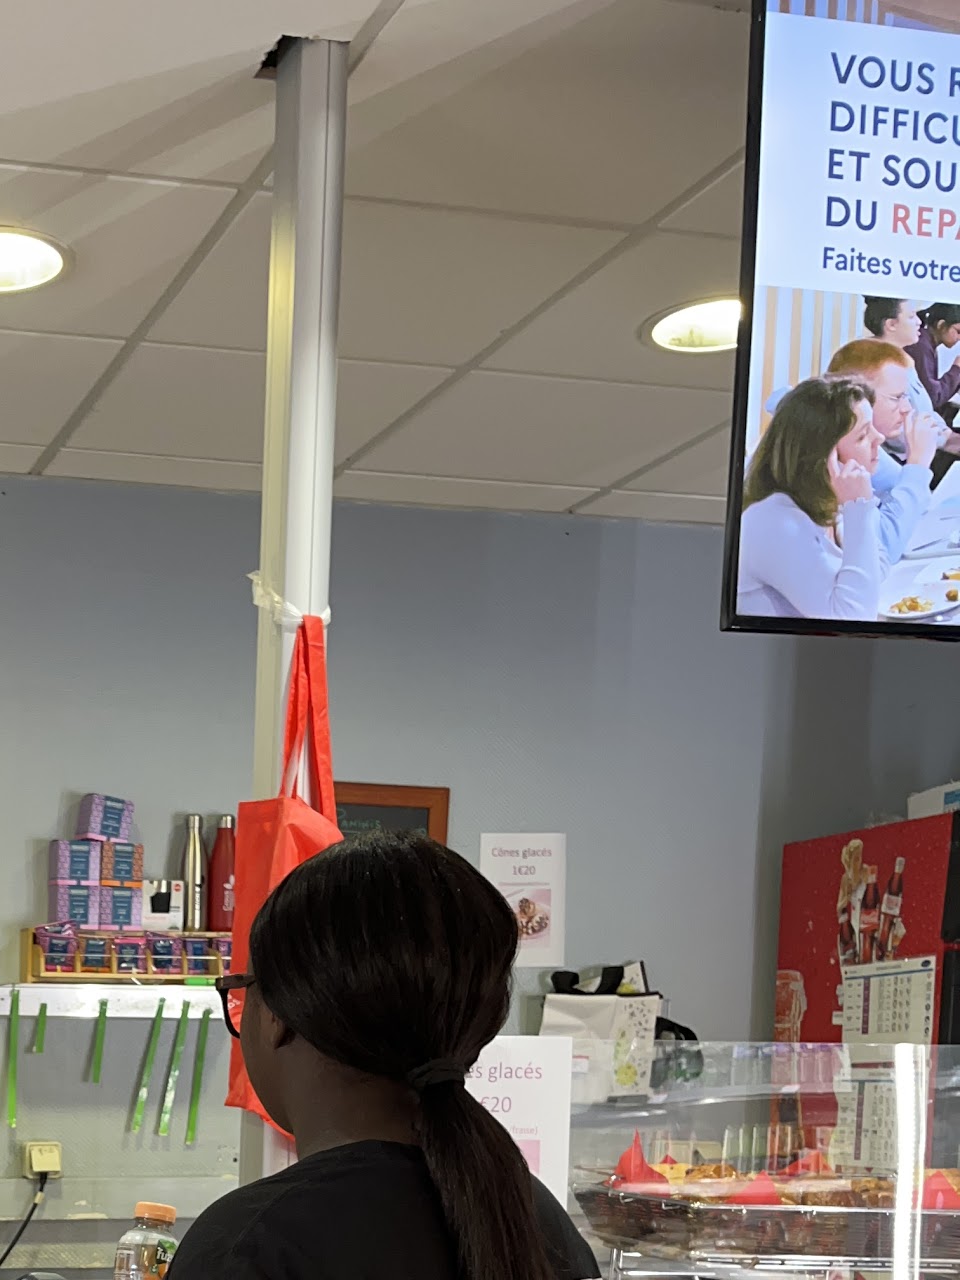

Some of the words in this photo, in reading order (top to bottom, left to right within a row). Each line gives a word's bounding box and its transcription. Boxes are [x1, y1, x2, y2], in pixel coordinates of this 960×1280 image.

[830, 52, 935, 95] VOUS
[827, 148, 871, 182] ET
[825, 196, 878, 231] DU
[892, 203, 960, 241] REP
[823, 246, 892, 276] Faites
[900, 258, 960, 283] votre
[491, 847, 520, 857] Cônes
[522, 848, 552, 859] glacés
[512, 865, 536, 875] 1€20
[487, 1061, 542, 1083] glacés
